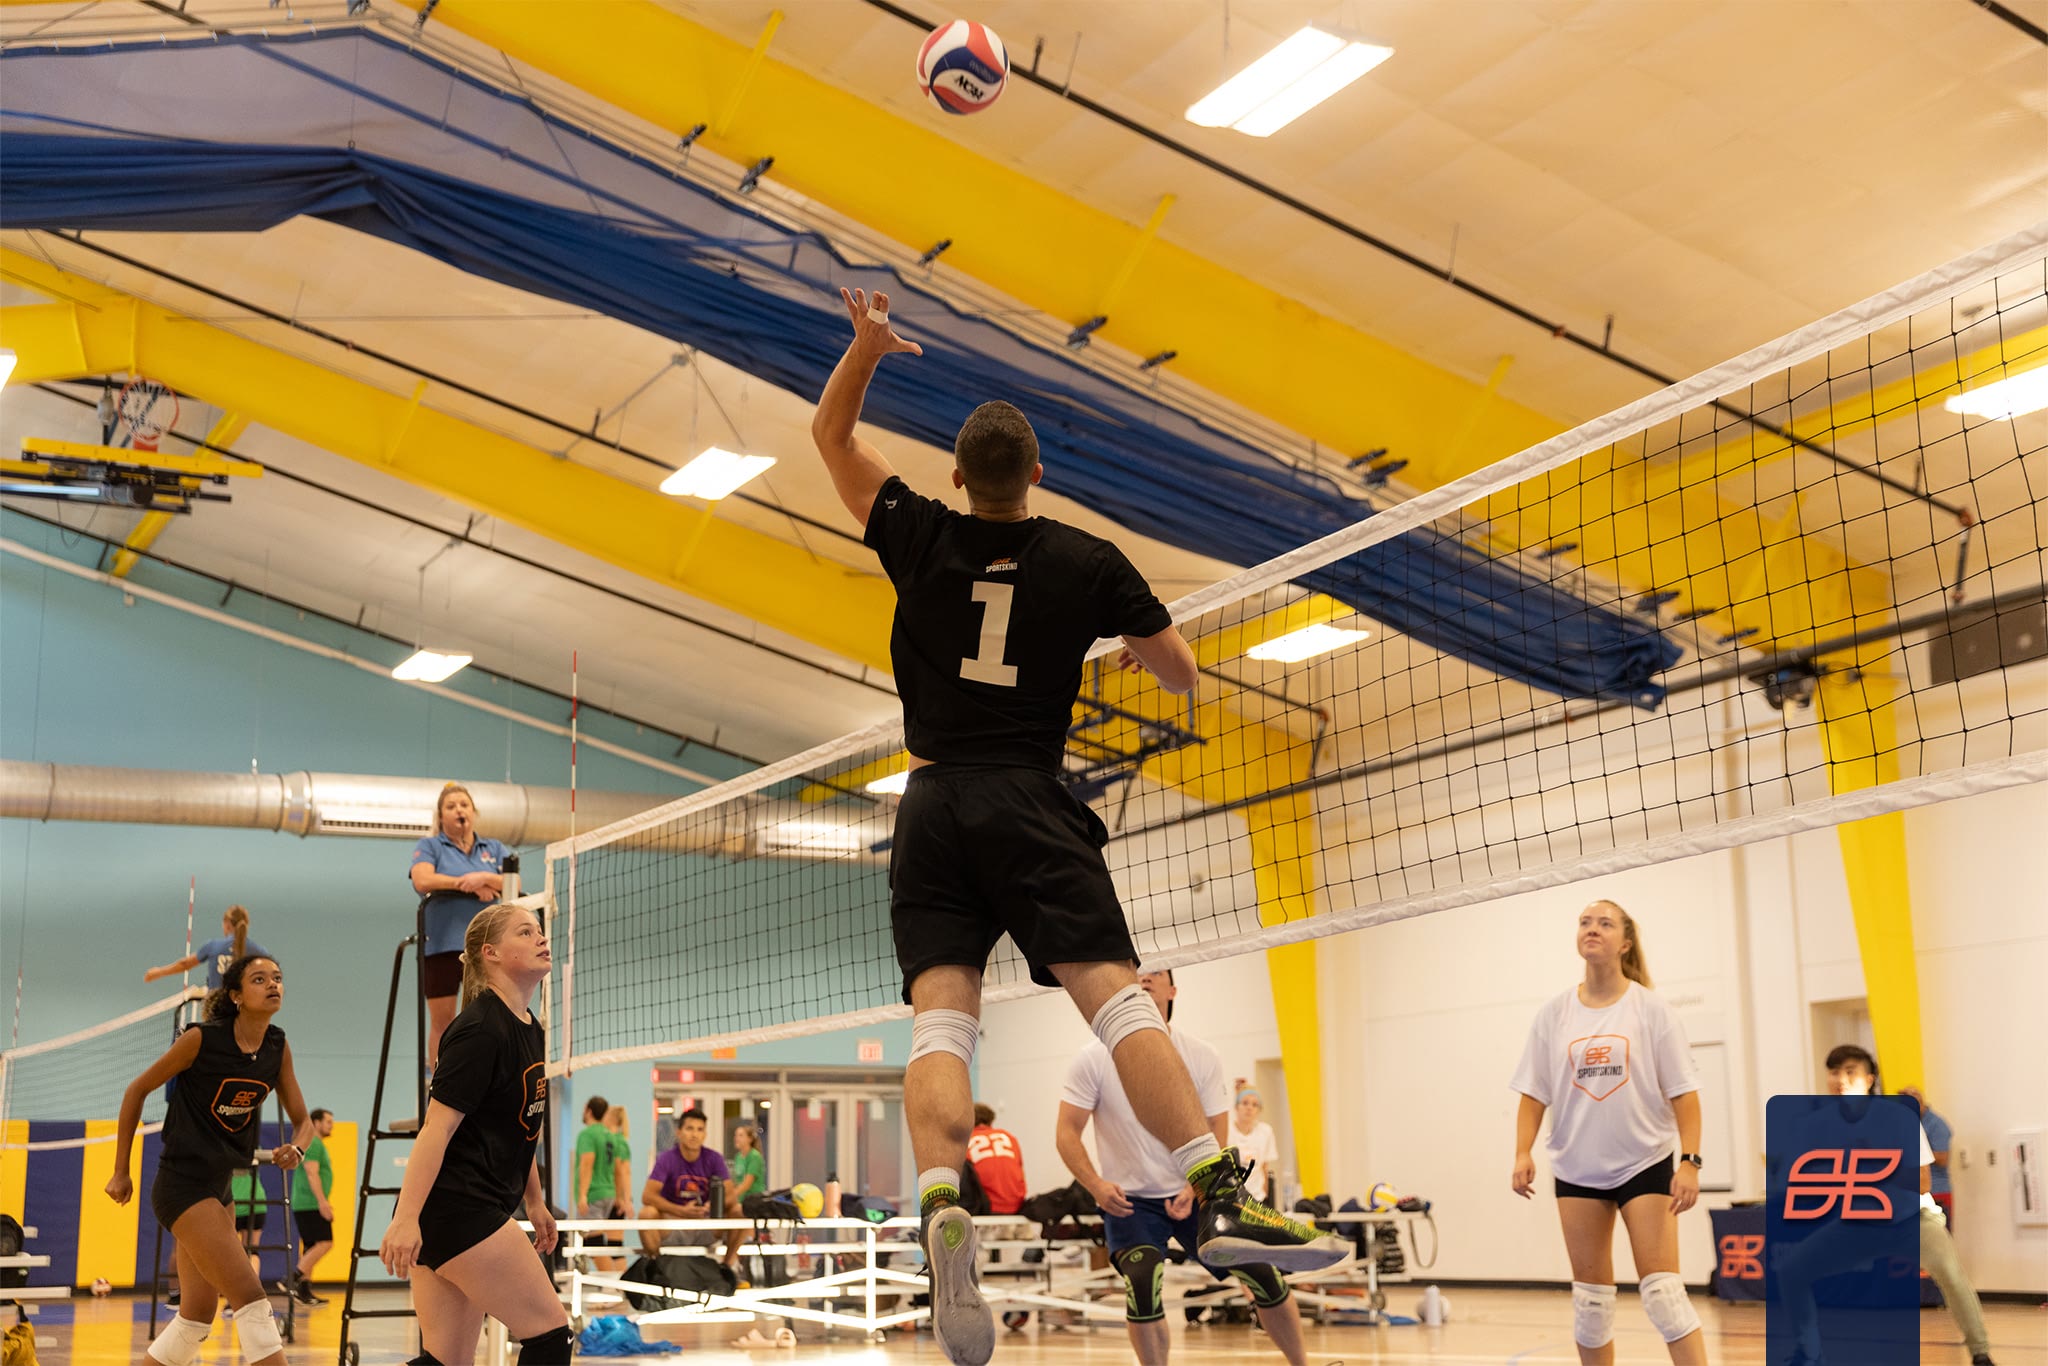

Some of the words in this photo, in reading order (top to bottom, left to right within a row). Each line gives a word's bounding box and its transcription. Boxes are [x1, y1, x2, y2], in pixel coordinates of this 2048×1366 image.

[985, 562, 1018, 573] SPORTSKIND
[959, 581, 1018, 687] 1
[1577, 1065, 1623, 1079] SPORTSKIND
[968, 1132, 1016, 1163] 22
